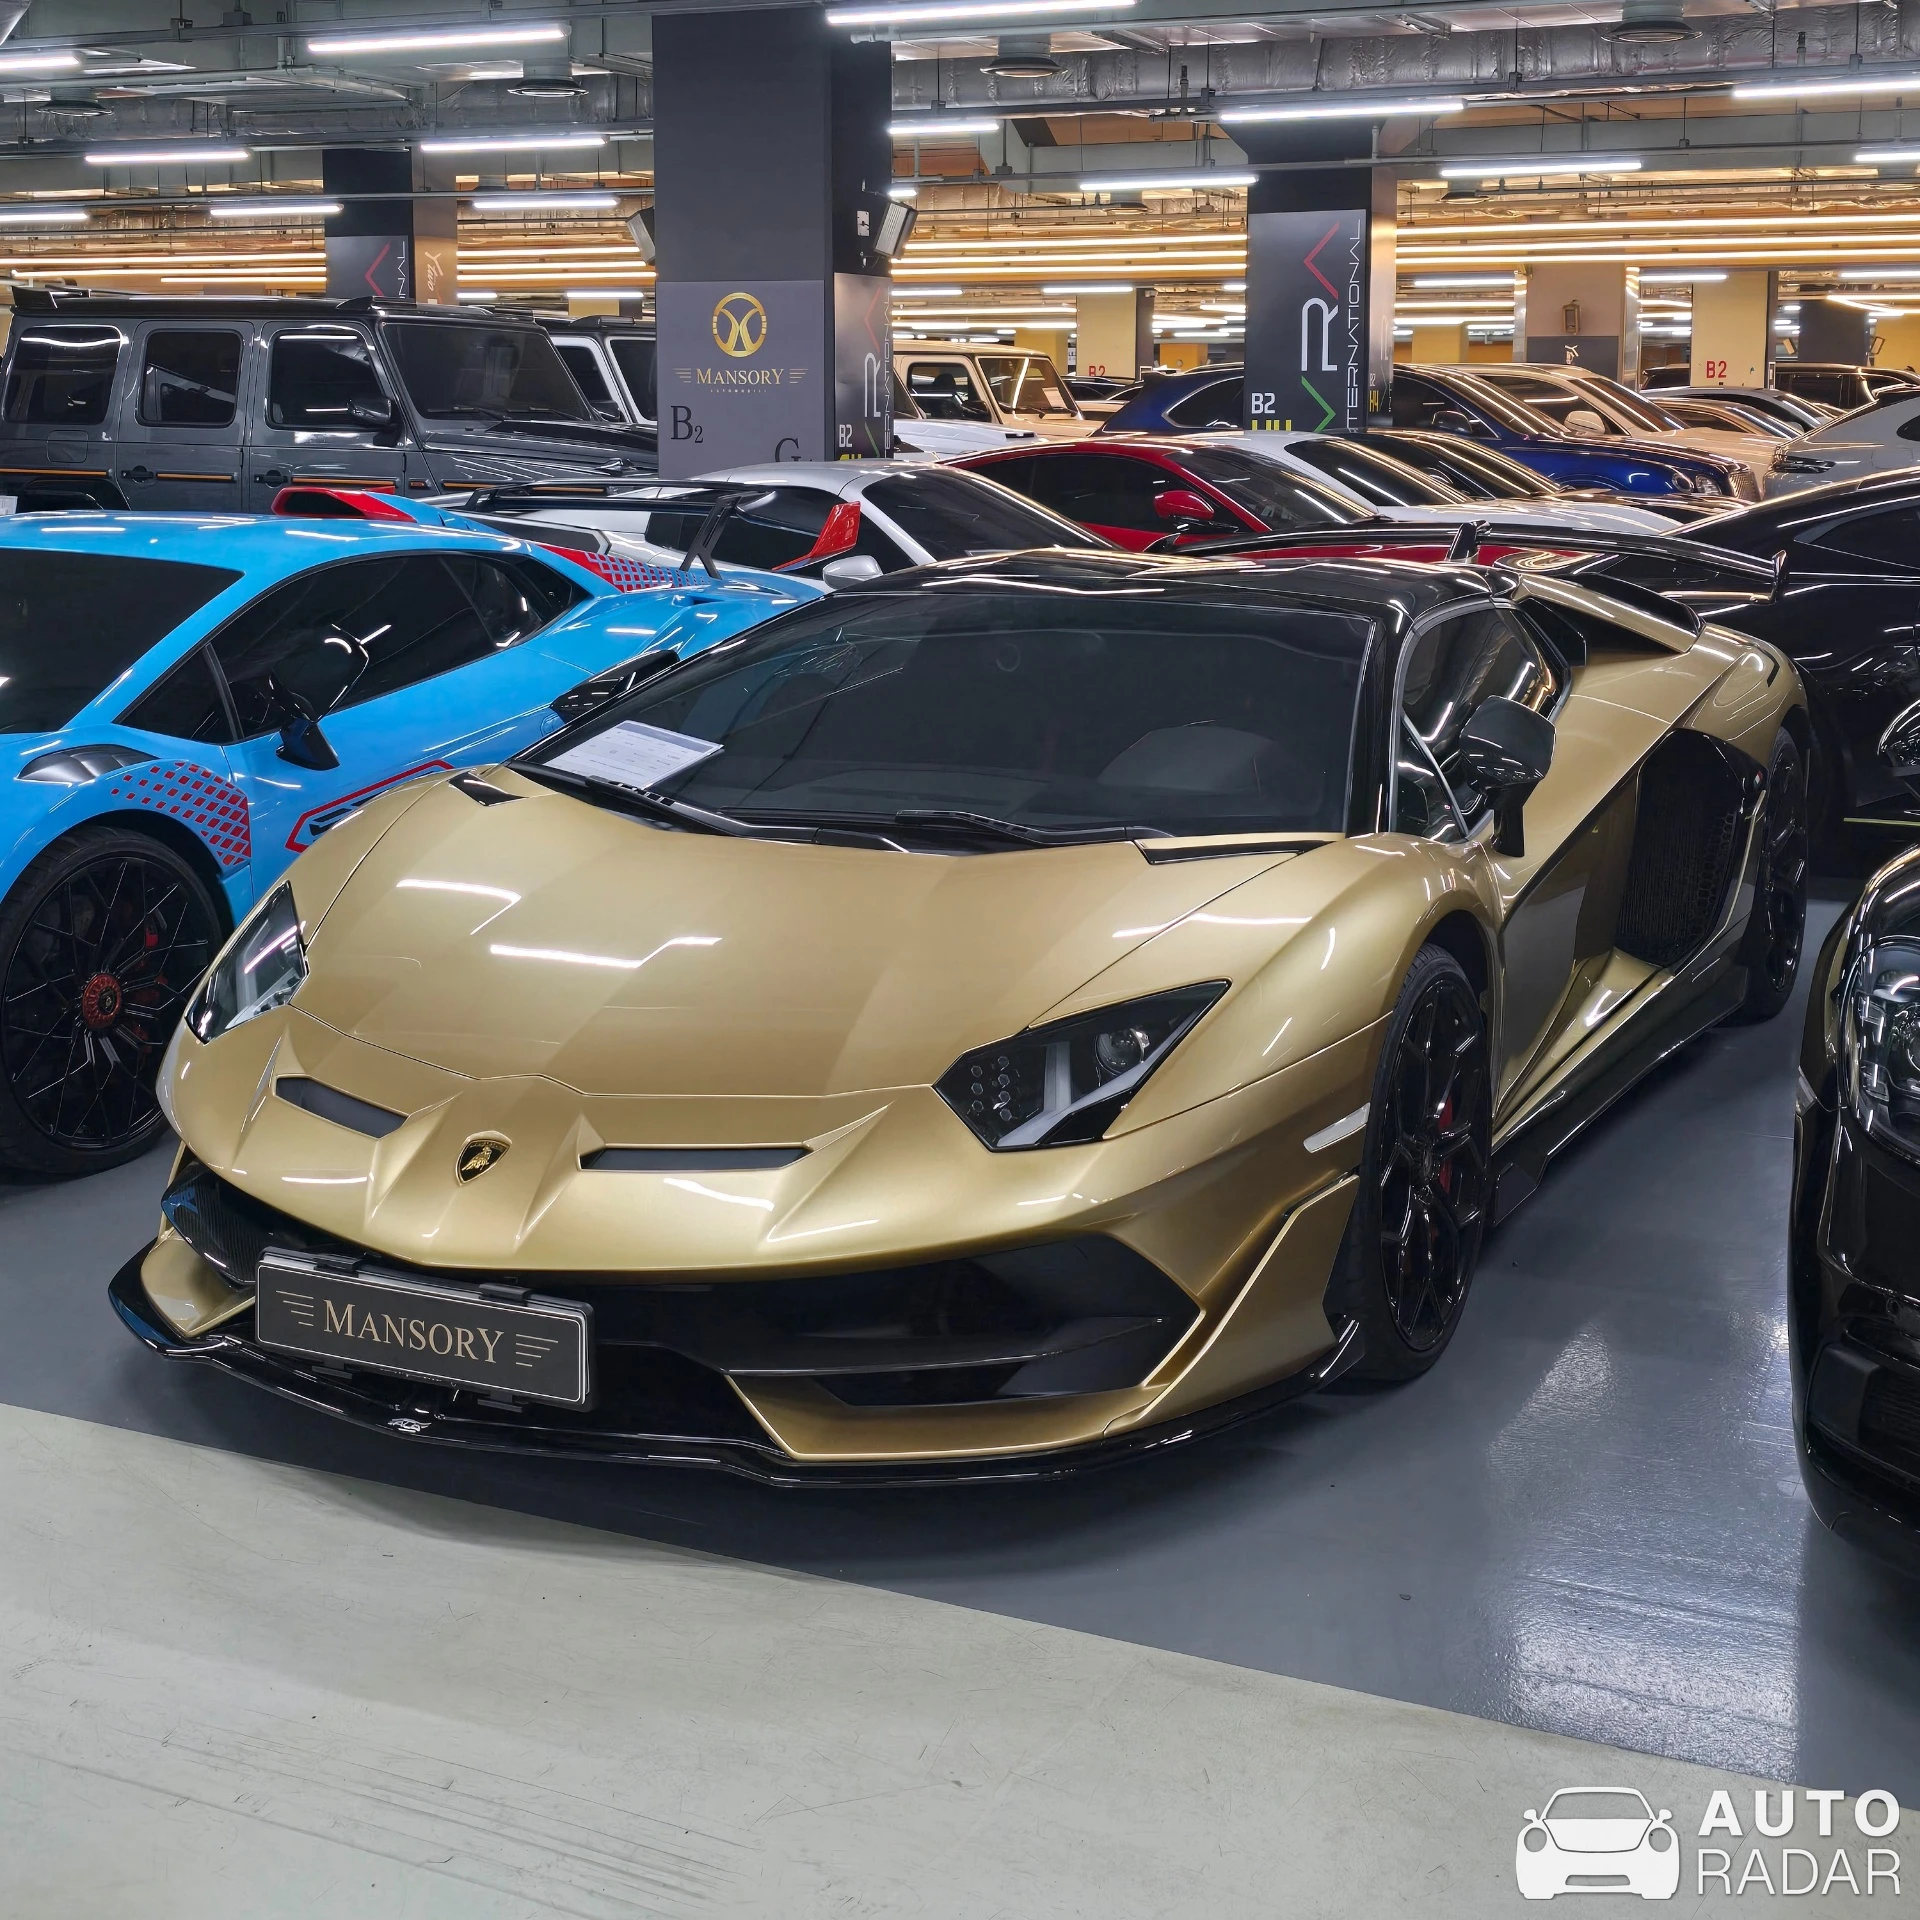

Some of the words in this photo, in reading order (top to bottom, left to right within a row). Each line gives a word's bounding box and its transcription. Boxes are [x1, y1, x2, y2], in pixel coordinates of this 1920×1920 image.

[1346, 219, 1361, 431] TERNATIONAL
[696, 368, 784, 385] MANSORY
[1706, 360, 1727, 379] B2
[1251, 392, 1276, 414] B2
[838, 424, 853, 448] B2
[323, 1299, 505, 1363] MANSORY
